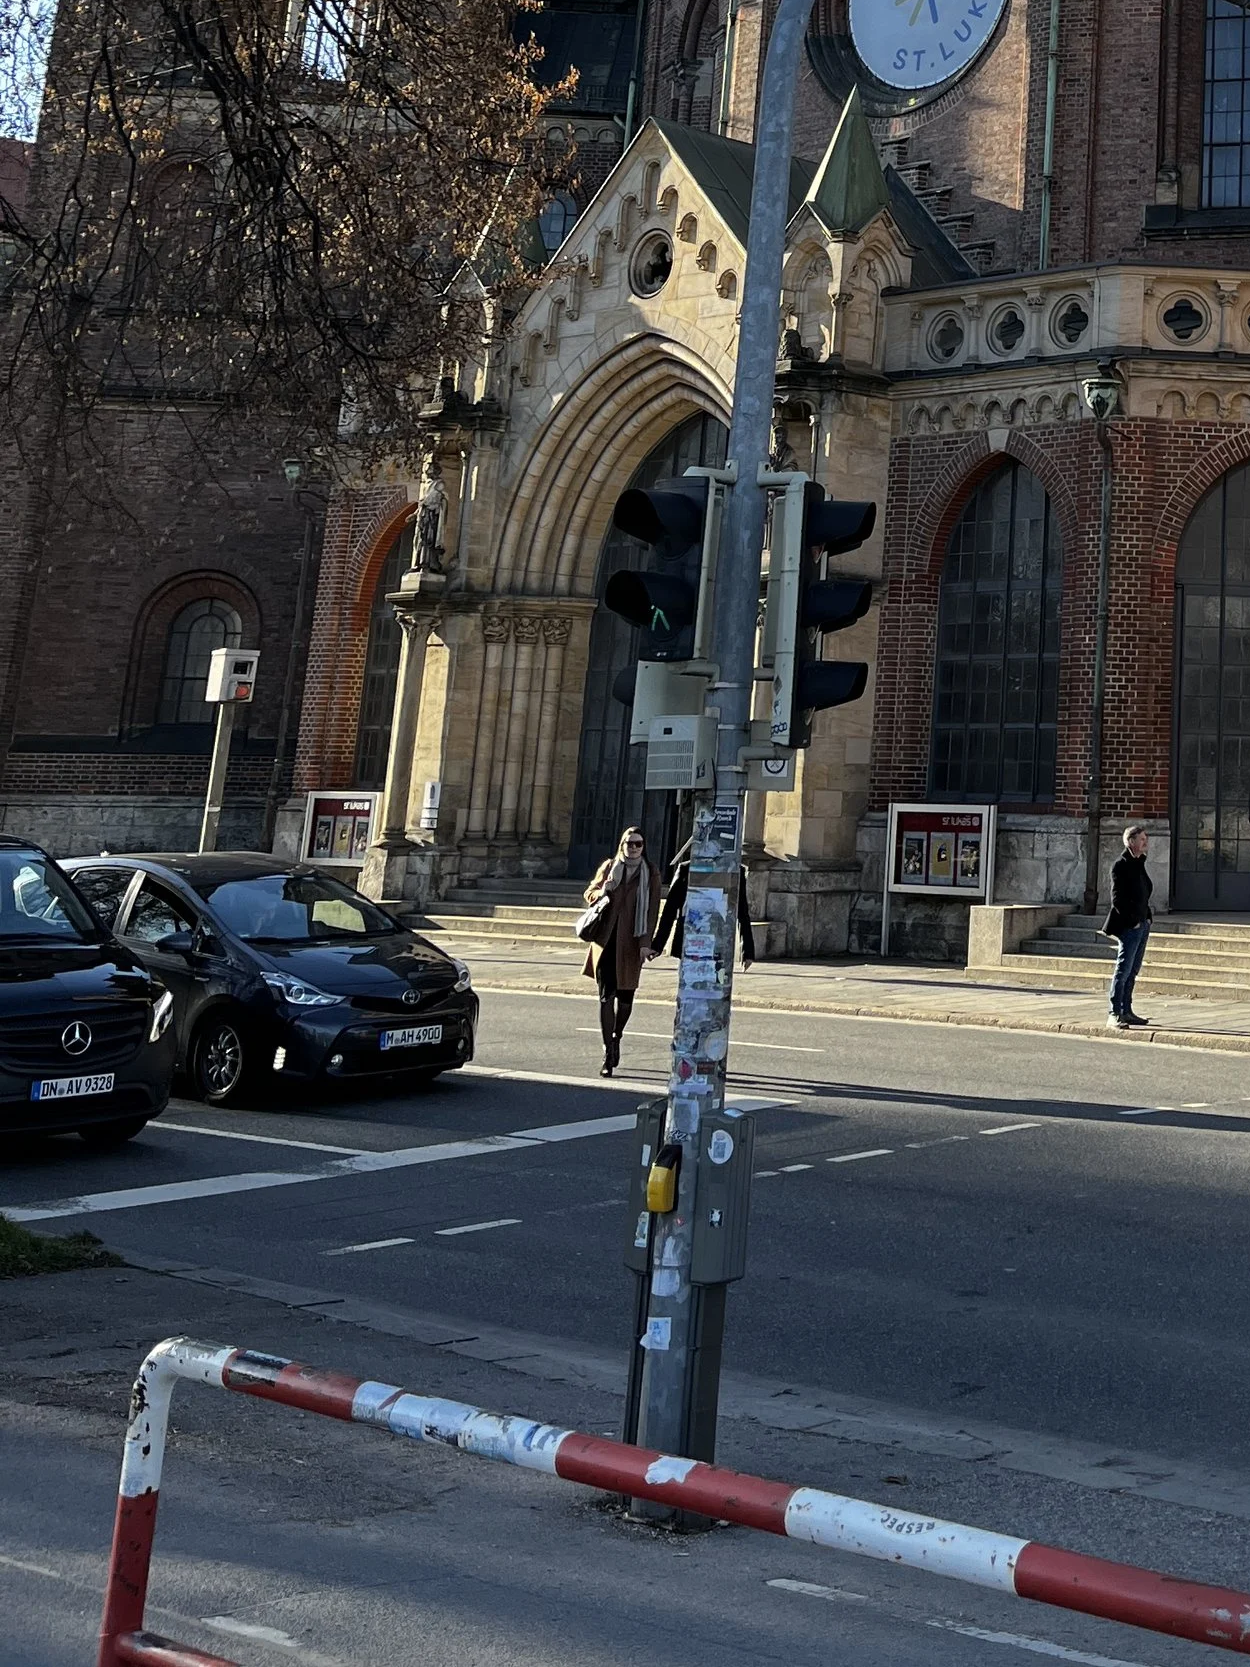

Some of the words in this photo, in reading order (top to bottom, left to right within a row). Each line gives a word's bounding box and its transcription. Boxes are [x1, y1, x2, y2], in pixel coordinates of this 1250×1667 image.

[386, 1031, 394, 1045] M
[400, 1030, 414, 1043] AH
[415, 1026, 440, 1042] 4900
[41, 1081, 58, 1097] DN
[66, 1078, 82, 1095] AV
[84, 1075, 113, 1093] 9328
